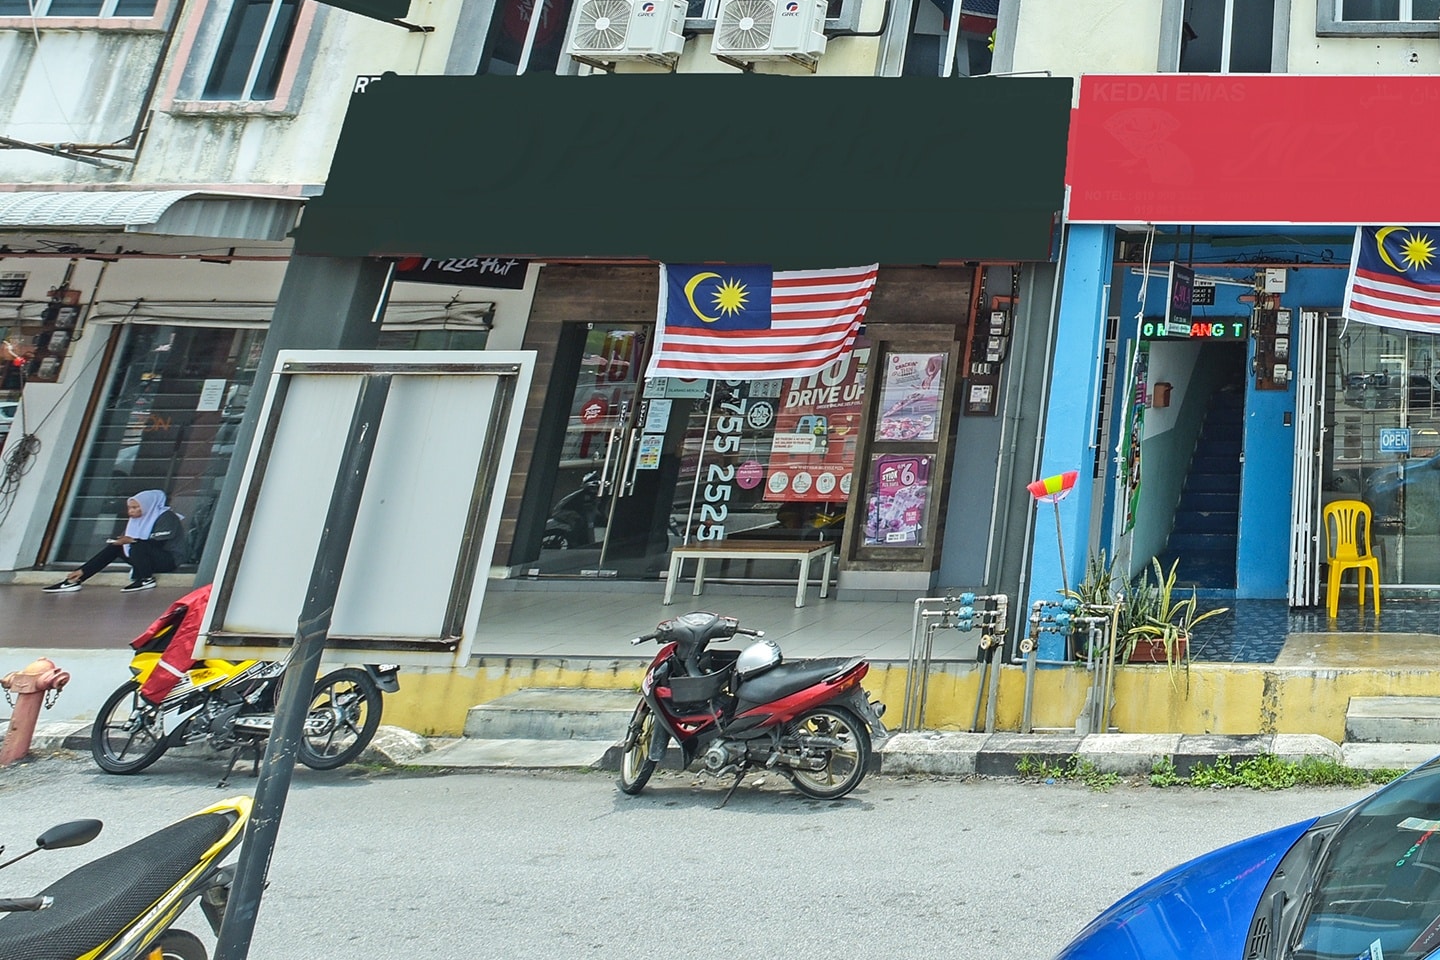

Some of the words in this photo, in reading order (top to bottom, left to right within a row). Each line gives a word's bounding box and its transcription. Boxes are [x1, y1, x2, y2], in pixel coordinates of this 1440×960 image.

[480, 257, 519, 276] Hut
[1232, 323, 1243, 337] T
[785, 386, 841, 409] DRIVE
[1382, 434, 1407, 447] OPEN
[901, 463, 915, 486] 6
[697, 464, 735, 541] 2525
